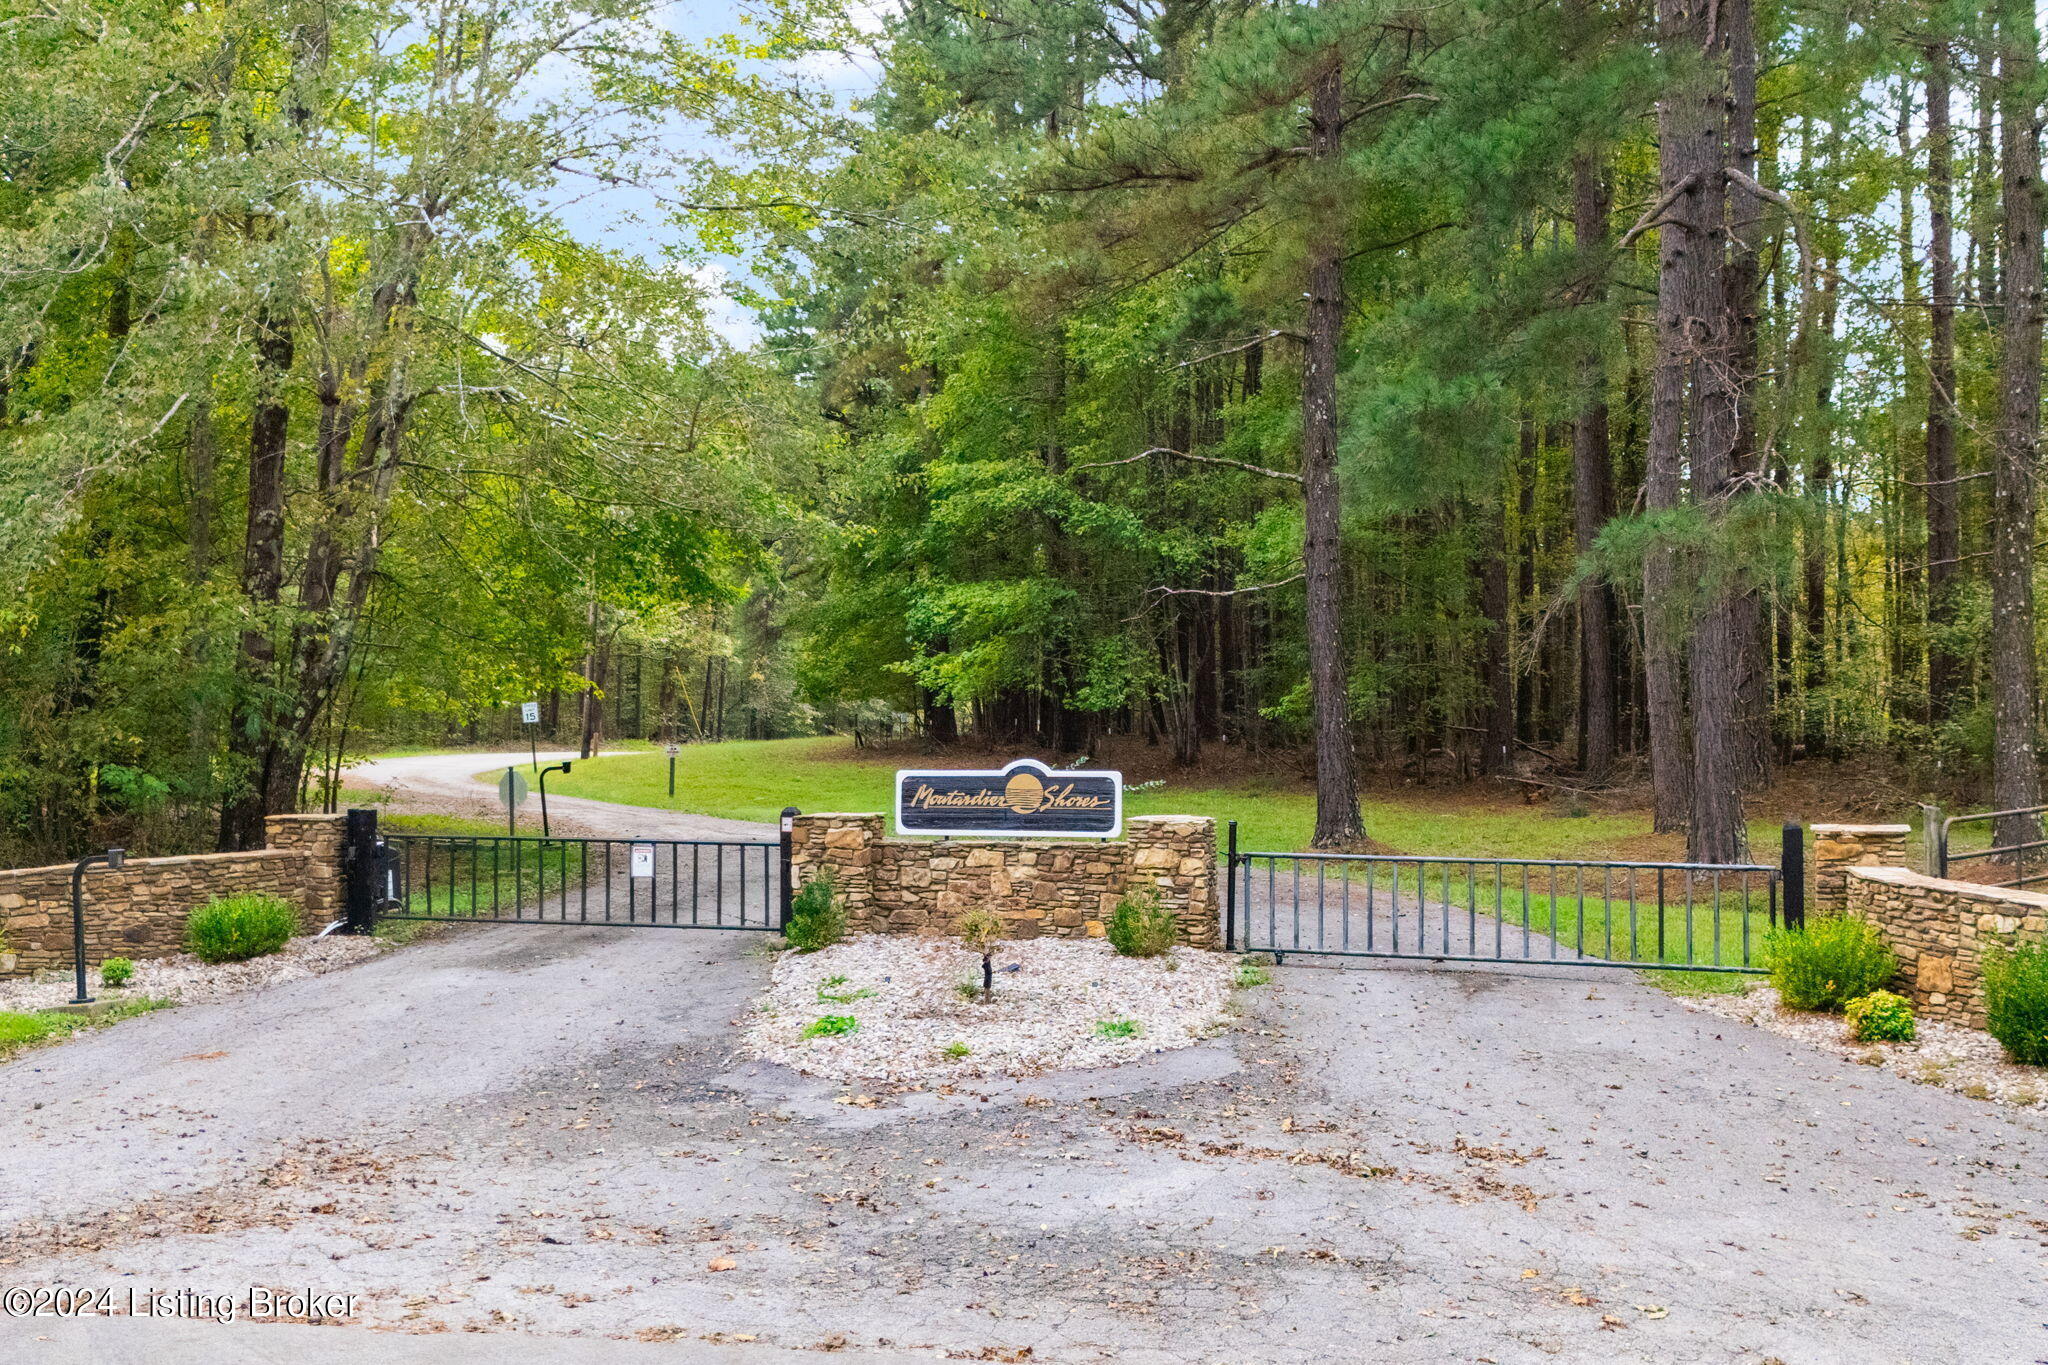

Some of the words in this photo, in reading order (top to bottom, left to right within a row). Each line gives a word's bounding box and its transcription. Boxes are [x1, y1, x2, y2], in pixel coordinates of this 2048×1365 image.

[526, 712, 536, 721] 15
[910, 784, 1007, 809] Moutardier
[1039, 783, 1110, 812] Shores
